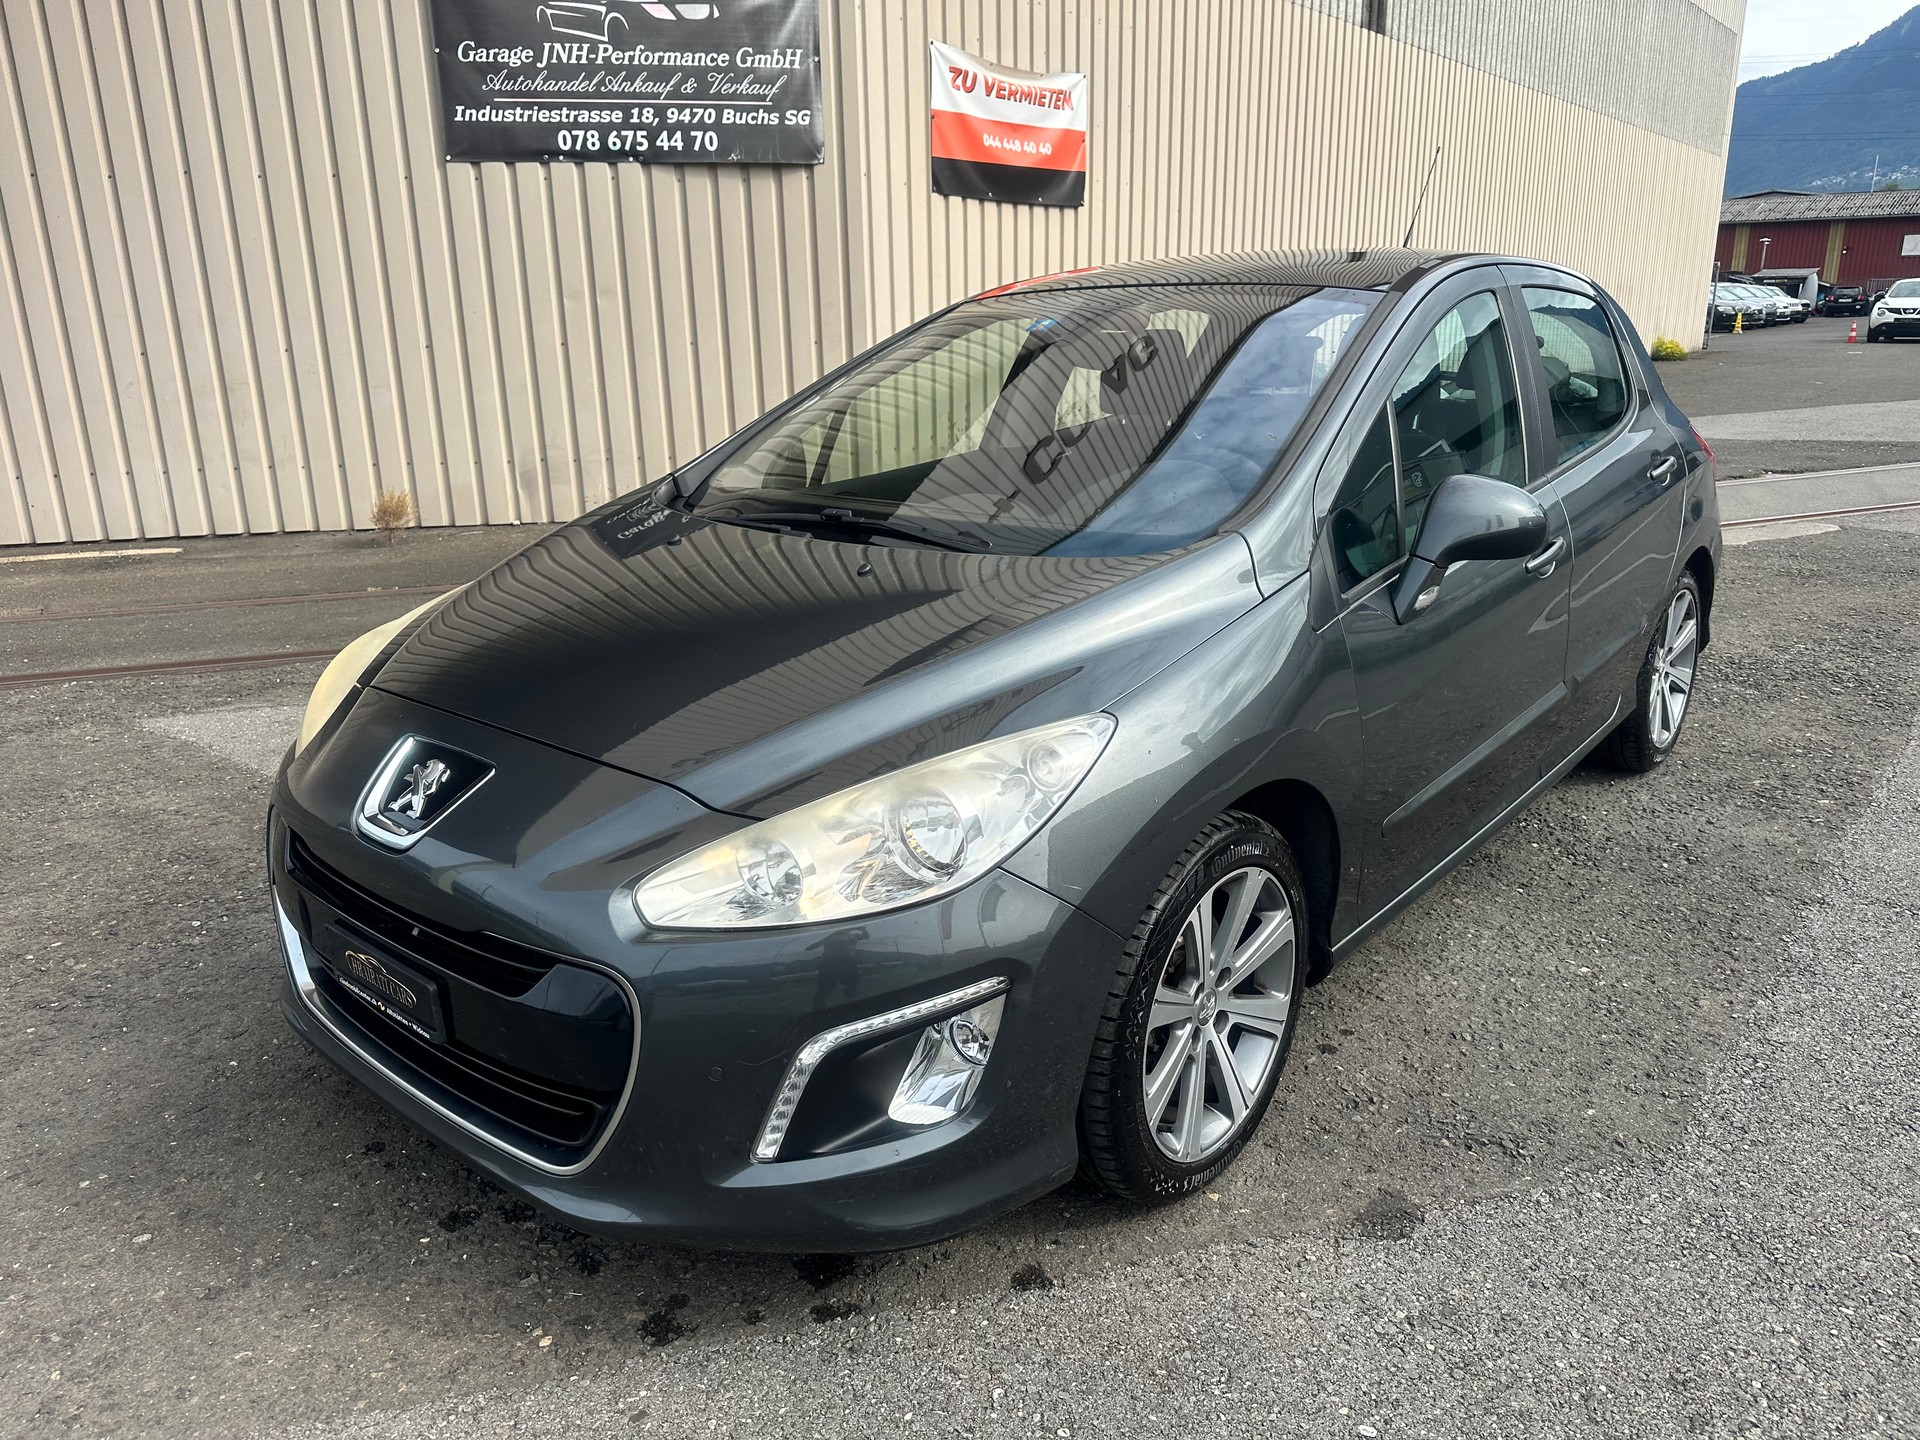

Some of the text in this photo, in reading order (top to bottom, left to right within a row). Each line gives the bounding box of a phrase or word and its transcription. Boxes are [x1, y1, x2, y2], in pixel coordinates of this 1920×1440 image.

[457, 41, 803, 70] Garage JNH-Performance GmbH
[482, 69, 788, 102] Autohandel Ankauf & Verkauf
[948, 66, 1074, 110] ZU VERMIETEN
[454, 104, 811, 127] Industriestrasse 18, 9470 Buchs SG
[557, 129, 719, 152] 078 675 44 70
[983, 133, 1052, 155] 044 448 40 40
[1211, 838, 1264, 878] Continental
